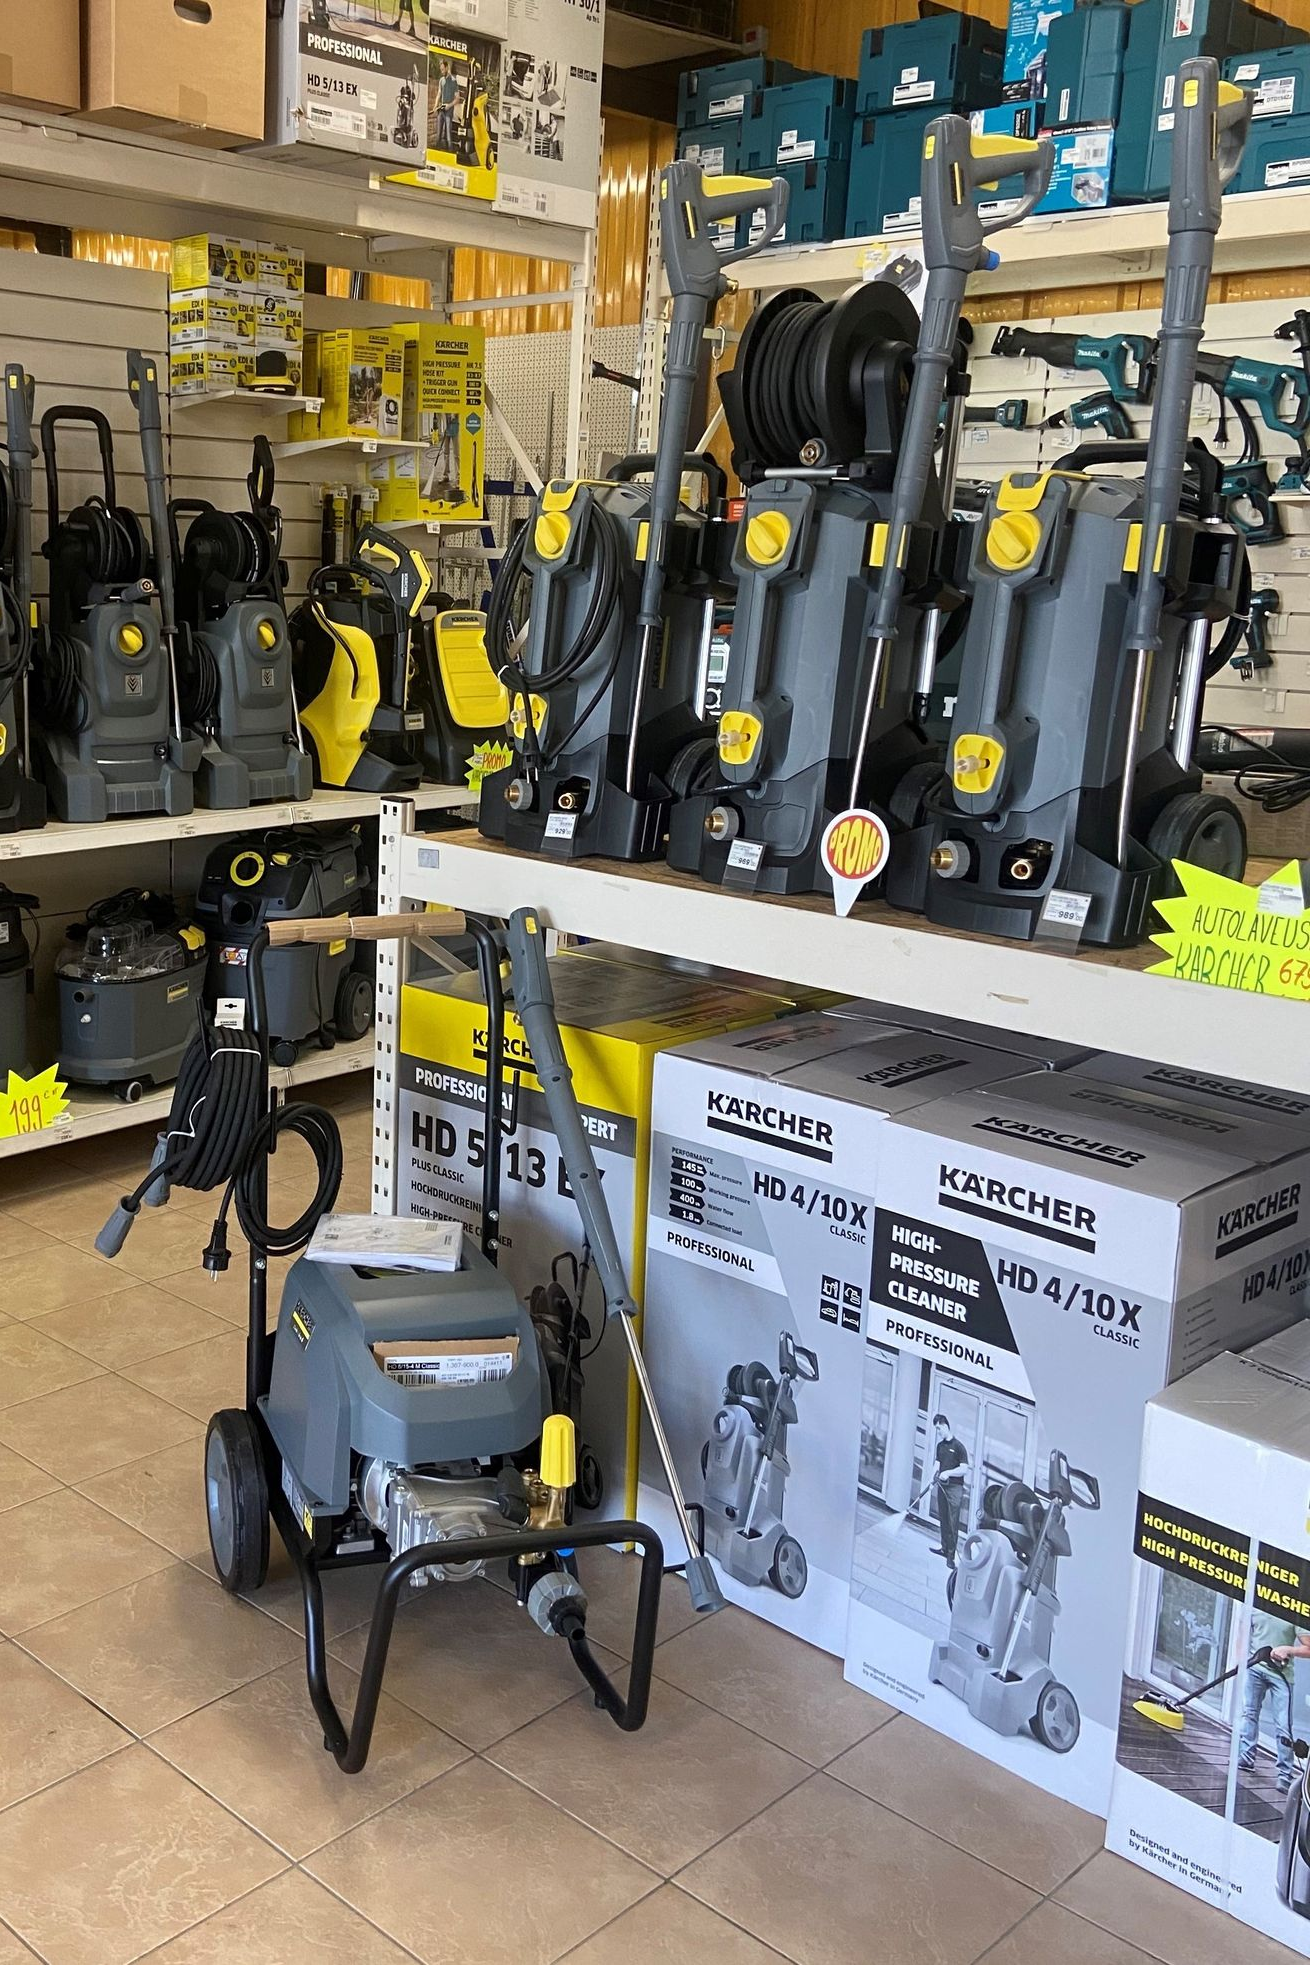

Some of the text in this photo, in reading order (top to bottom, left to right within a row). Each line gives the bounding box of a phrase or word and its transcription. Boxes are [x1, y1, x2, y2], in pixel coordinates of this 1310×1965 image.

[307, 32, 383, 66] PROFESSIONAL
[307, 73, 358, 97] HD 5/13 EX
[436, 361, 461, 369] PRESSURE
[423, 388, 437, 396] QUICK
[482, 752, 506, 770] PROMO
[829, 818, 881, 875] PROMO
[1058, 911, 1075, 920] 989
[857, 1054, 953, 1085] KÄRCHER
[1150, 1068, 1310, 1112] KÄRCHER
[10, 1094, 42, 1134] 199
[707, 1090, 833, 1146] KÄRCHER
[412, 1111, 457, 1158] HD
[467, 1128, 546, 1188] 513
[672, 1146, 714, 1165] PERFORMANCE
[983, 1116, 1147, 1164] KÄRCHER
[411, 1157, 465, 1184] PLUS CLASSIC
[681, 1178, 696, 1188] 100
[682, 1160, 697, 1172] 145
[680, 1193, 695, 1205] 400
[754, 1171, 787, 1202] HD
[791, 1184, 847, 1223] 4/10
[939, 1164, 1096, 1234] KÄRCHER
[1217, 1183, 1301, 1240] KÄRCHER
[682, 1210, 694, 1220] 1.8
[667, 1231, 755, 1272] PROFESSIONAL
[830, 1225, 867, 1245] CLASSIC
[891, 1225, 942, 1254] HIGH-
[889, 1252, 980, 1298] PRESSURE
[997, 1258, 1038, 1294] HD
[1043, 1277, 1115, 1321] 4/10
[1242, 1271, 1265, 1304] HD
[887, 1280, 967, 1323] CLEANER
[886, 1318, 994, 1371] PROFESSIONAL
[1093, 1324, 1140, 1349] CLASSIC
[1141, 1535, 1176, 1561] HIGH
[1143, 1512, 1300, 1588] HOCHDRUCKRENIGER
[1128, 1838, 1140, 1851] by
[1142, 1845, 1177, 1870] Kärcher
[1178, 1865, 1188, 1876] in
[1129, 1828, 1171, 1856] Designed
[1171, 1851, 1189, 1865] and
